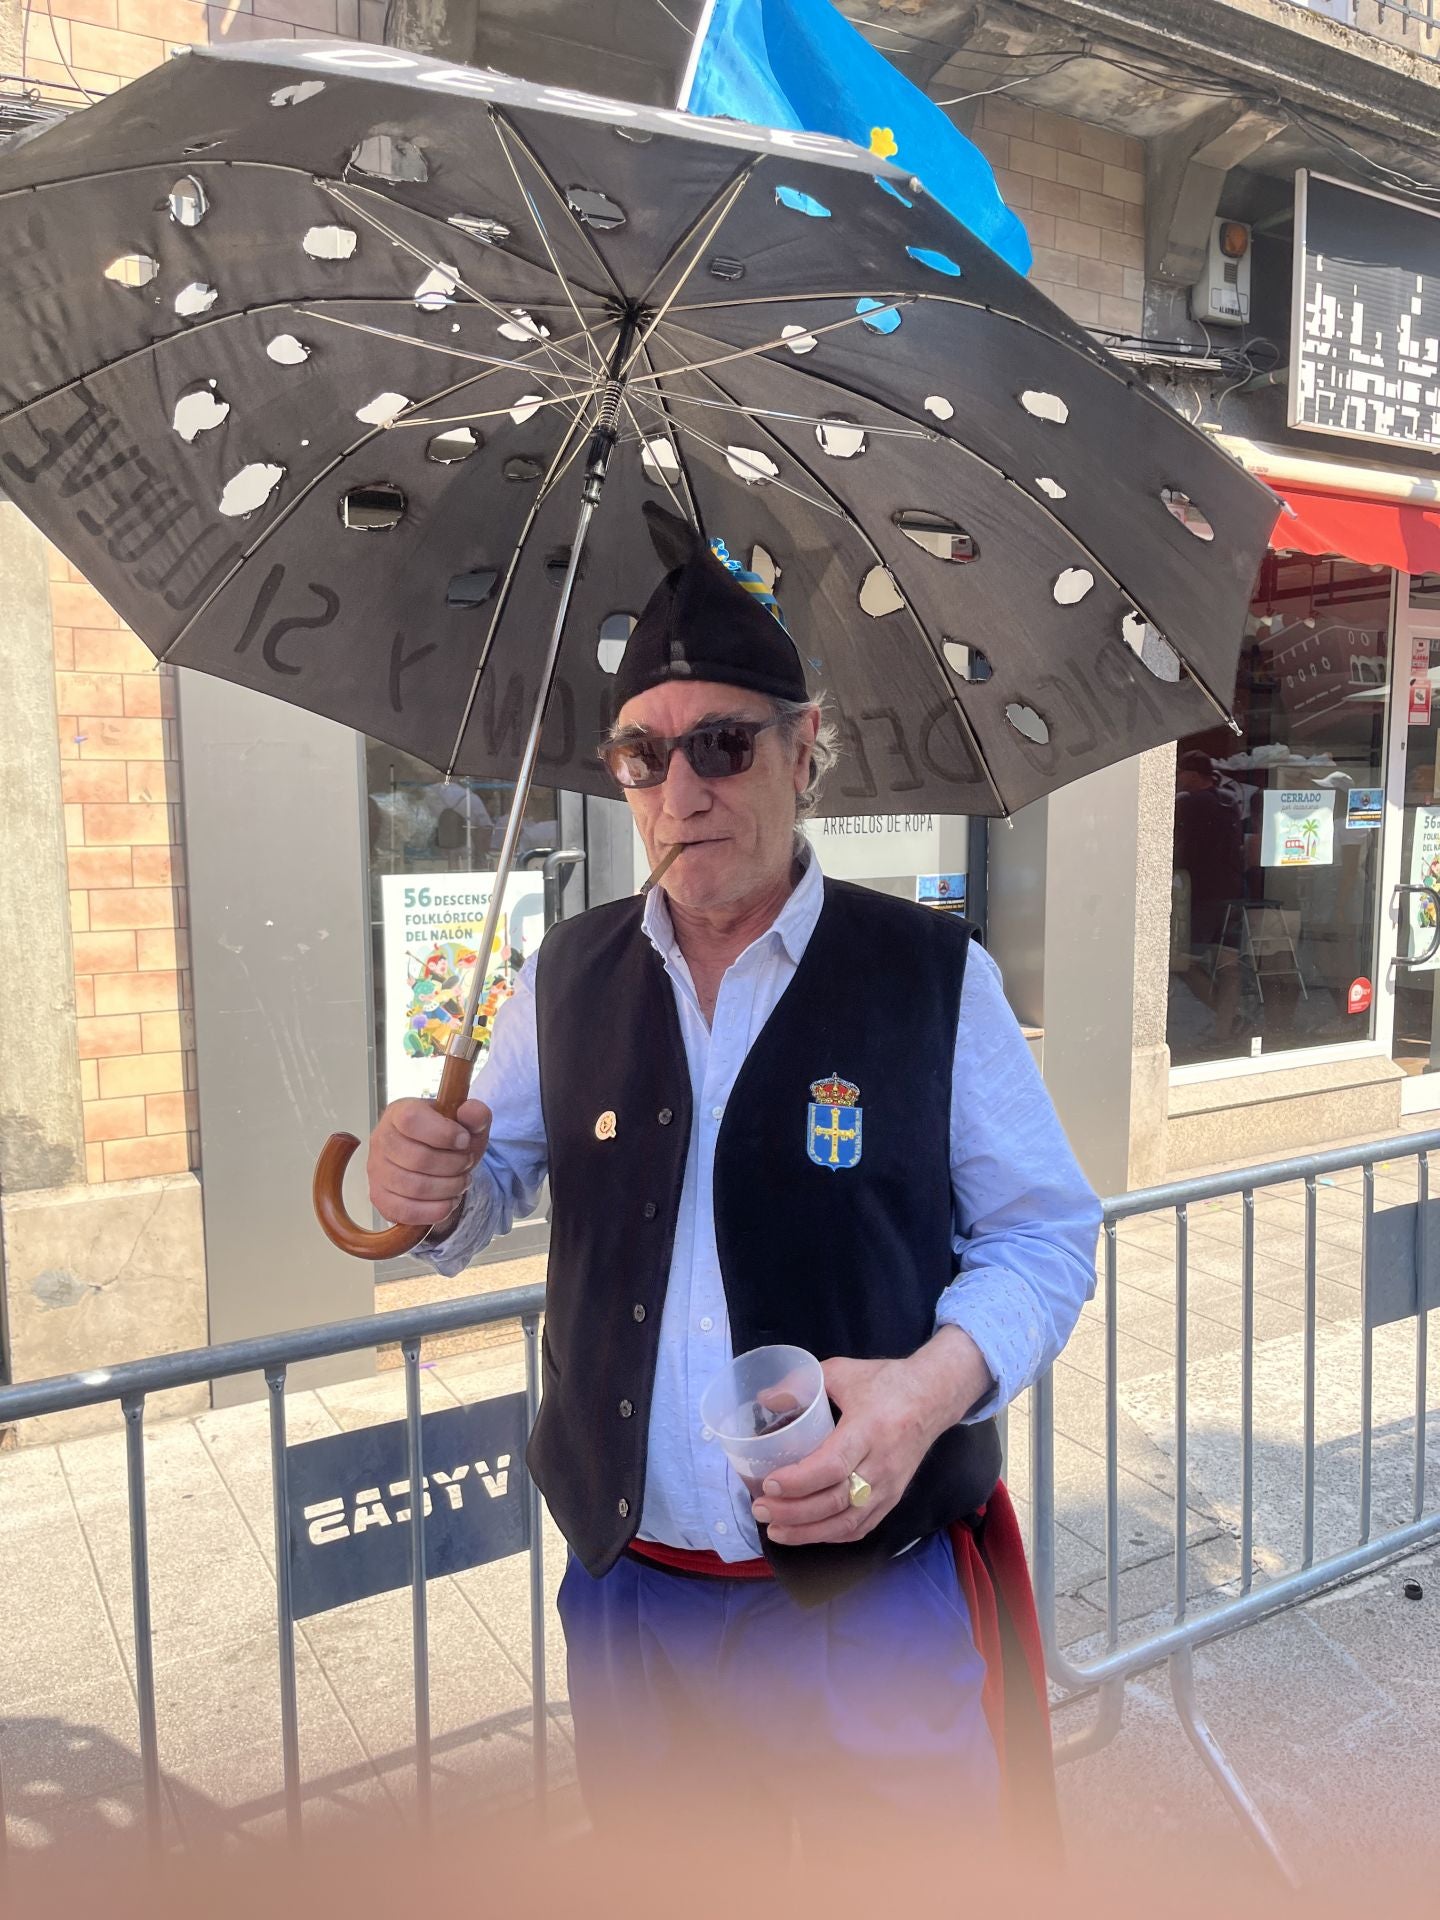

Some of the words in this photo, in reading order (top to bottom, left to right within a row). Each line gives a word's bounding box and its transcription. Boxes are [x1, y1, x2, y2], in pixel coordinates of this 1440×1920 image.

[1280, 792, 1322, 803] CERRADO
[823, 816, 883, 836] ARREGLOS
[887, 815, 902, 832] DE
[905, 814, 933, 832] ROPA
[1424, 816, 1436, 829] 56
[404, 887, 432, 908] 56
[405, 910, 484, 926] FOLKLÓRICO
[406, 930, 428, 942] DEL
[430, 925, 473, 941] NALÓN
